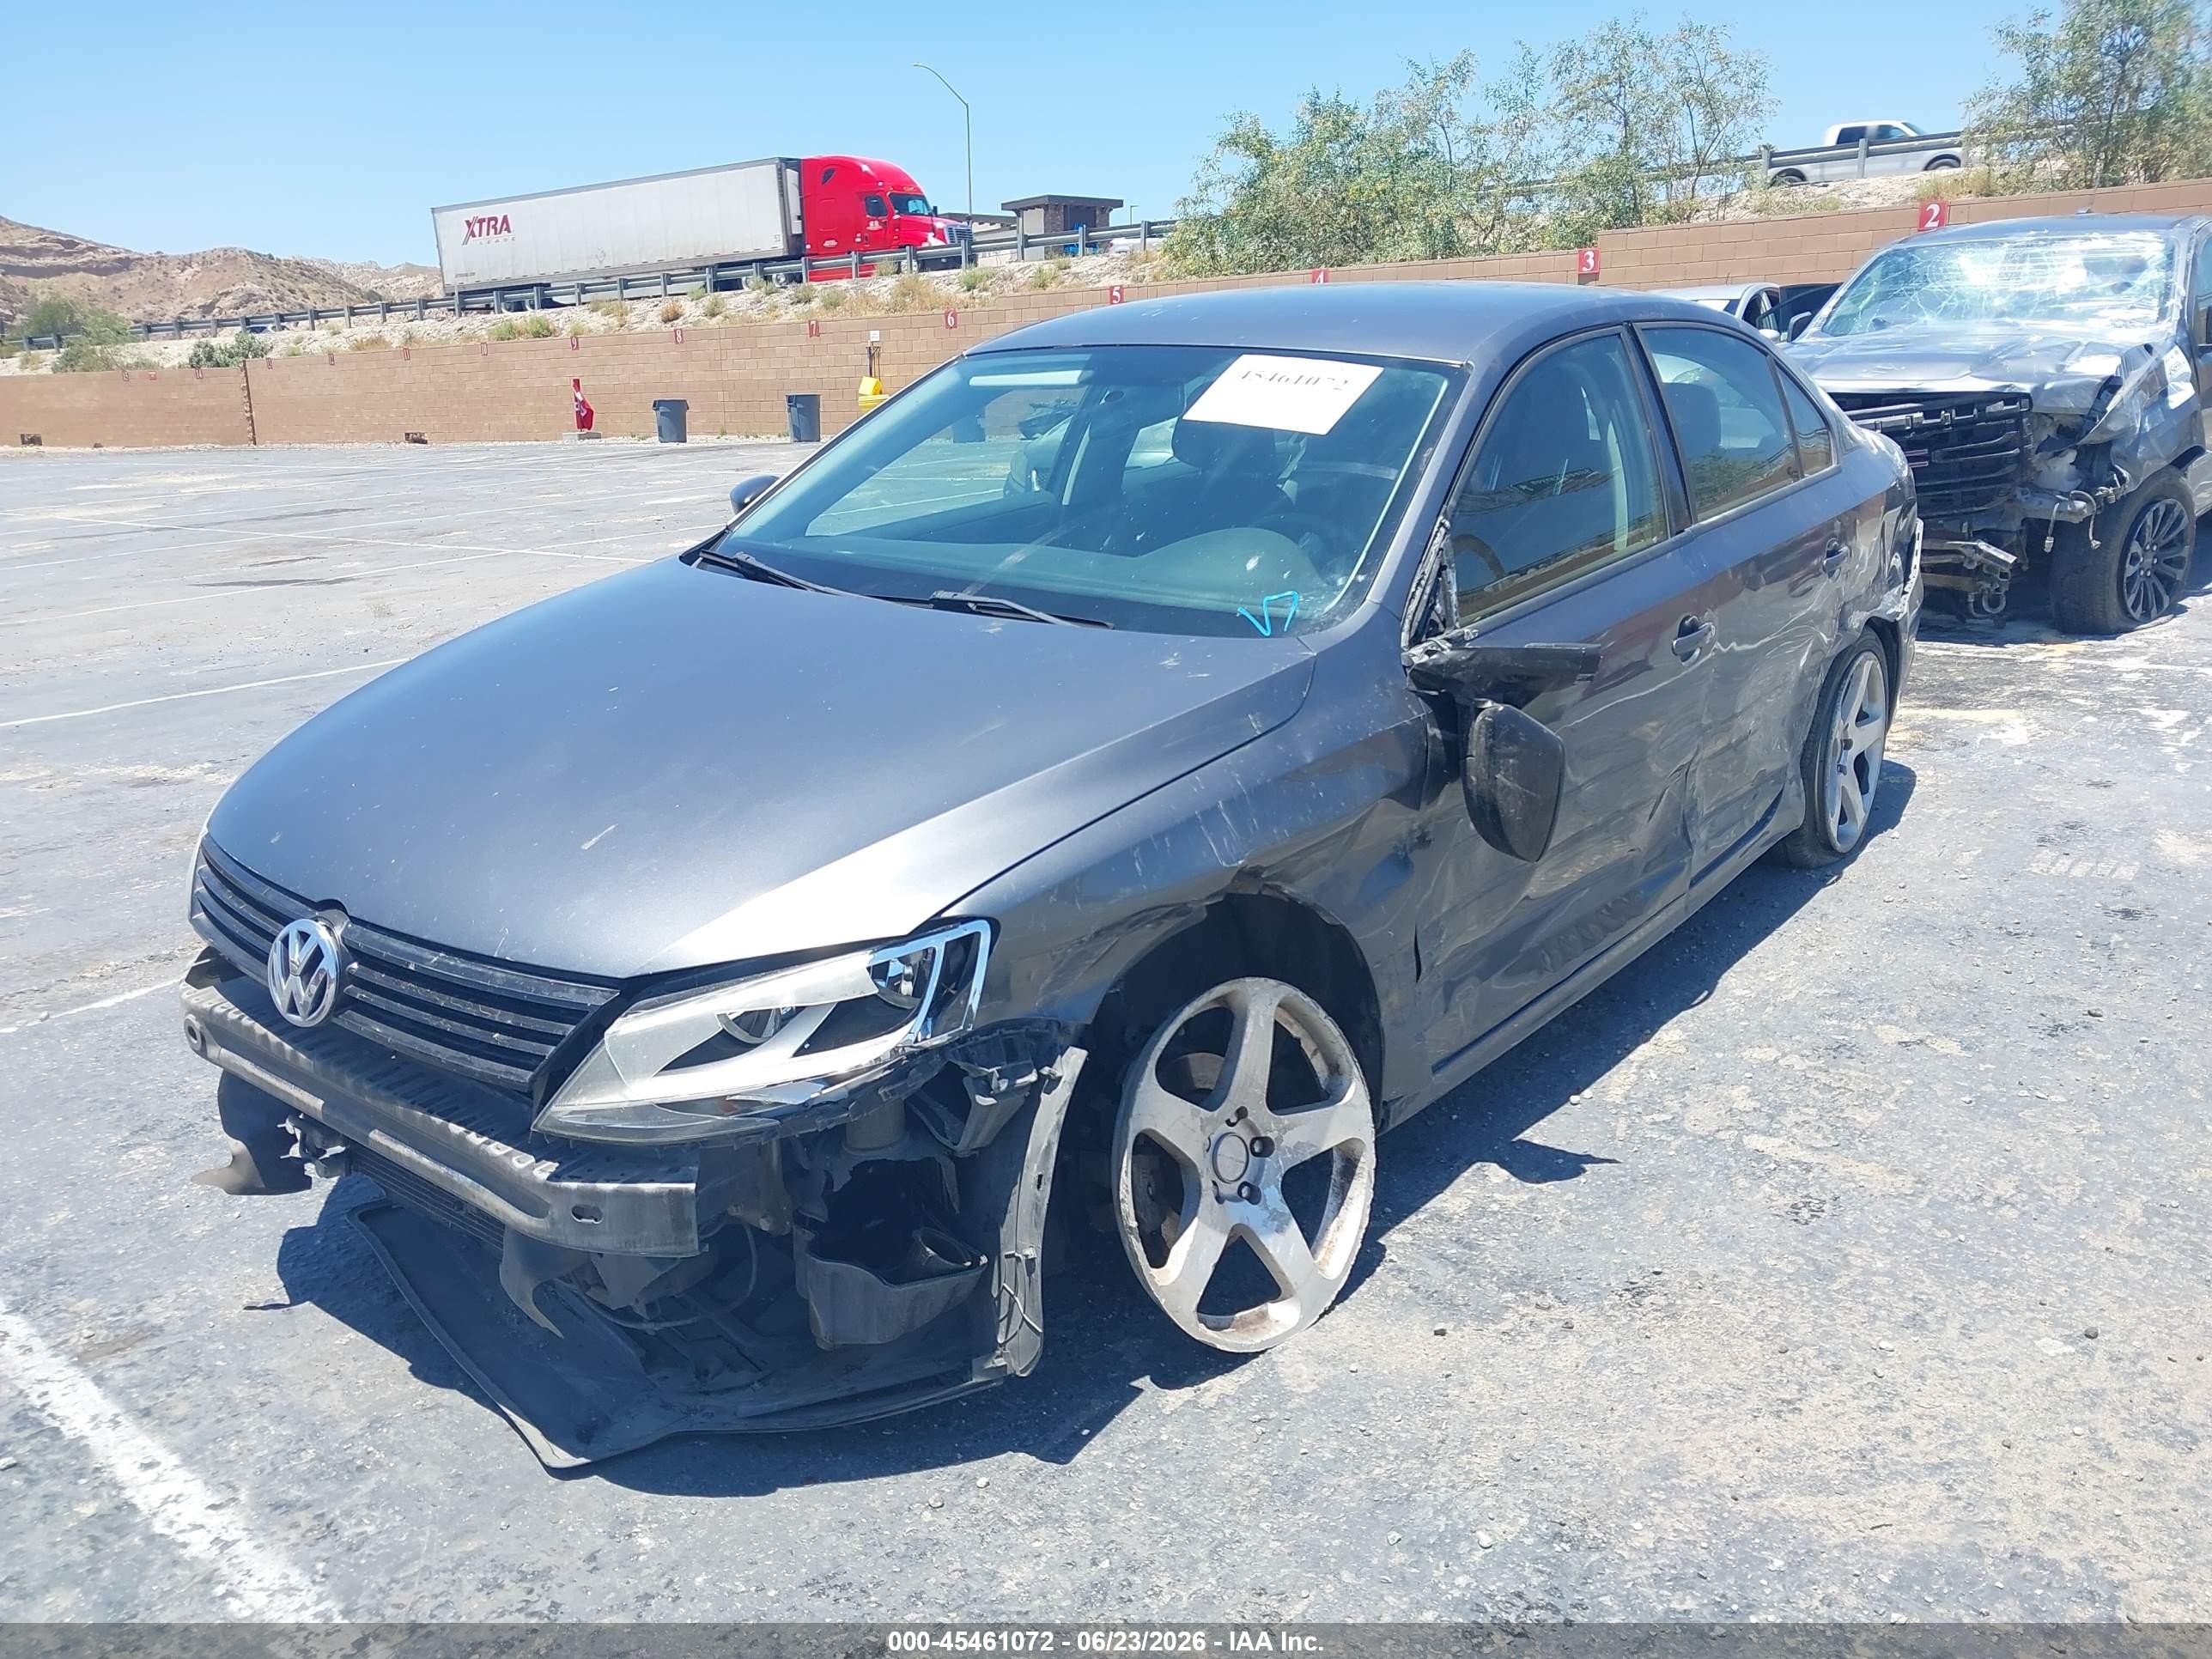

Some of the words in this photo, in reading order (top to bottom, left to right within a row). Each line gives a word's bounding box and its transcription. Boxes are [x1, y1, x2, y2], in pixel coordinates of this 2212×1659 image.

[1923, 204, 1941, 228] 2
[461, 214, 512, 246] XTRA
[1582, 251, 1595, 271] 3
[1112, 286, 1121, 304] 5
[810, 320, 817, 335] 7
[947, 311, 955, 327] 6
[572, 337, 577, 349] 9
[676, 329, 682, 343] 8
[481, 343, 488, 355] 10
[270, 921, 337, 1025] VW
